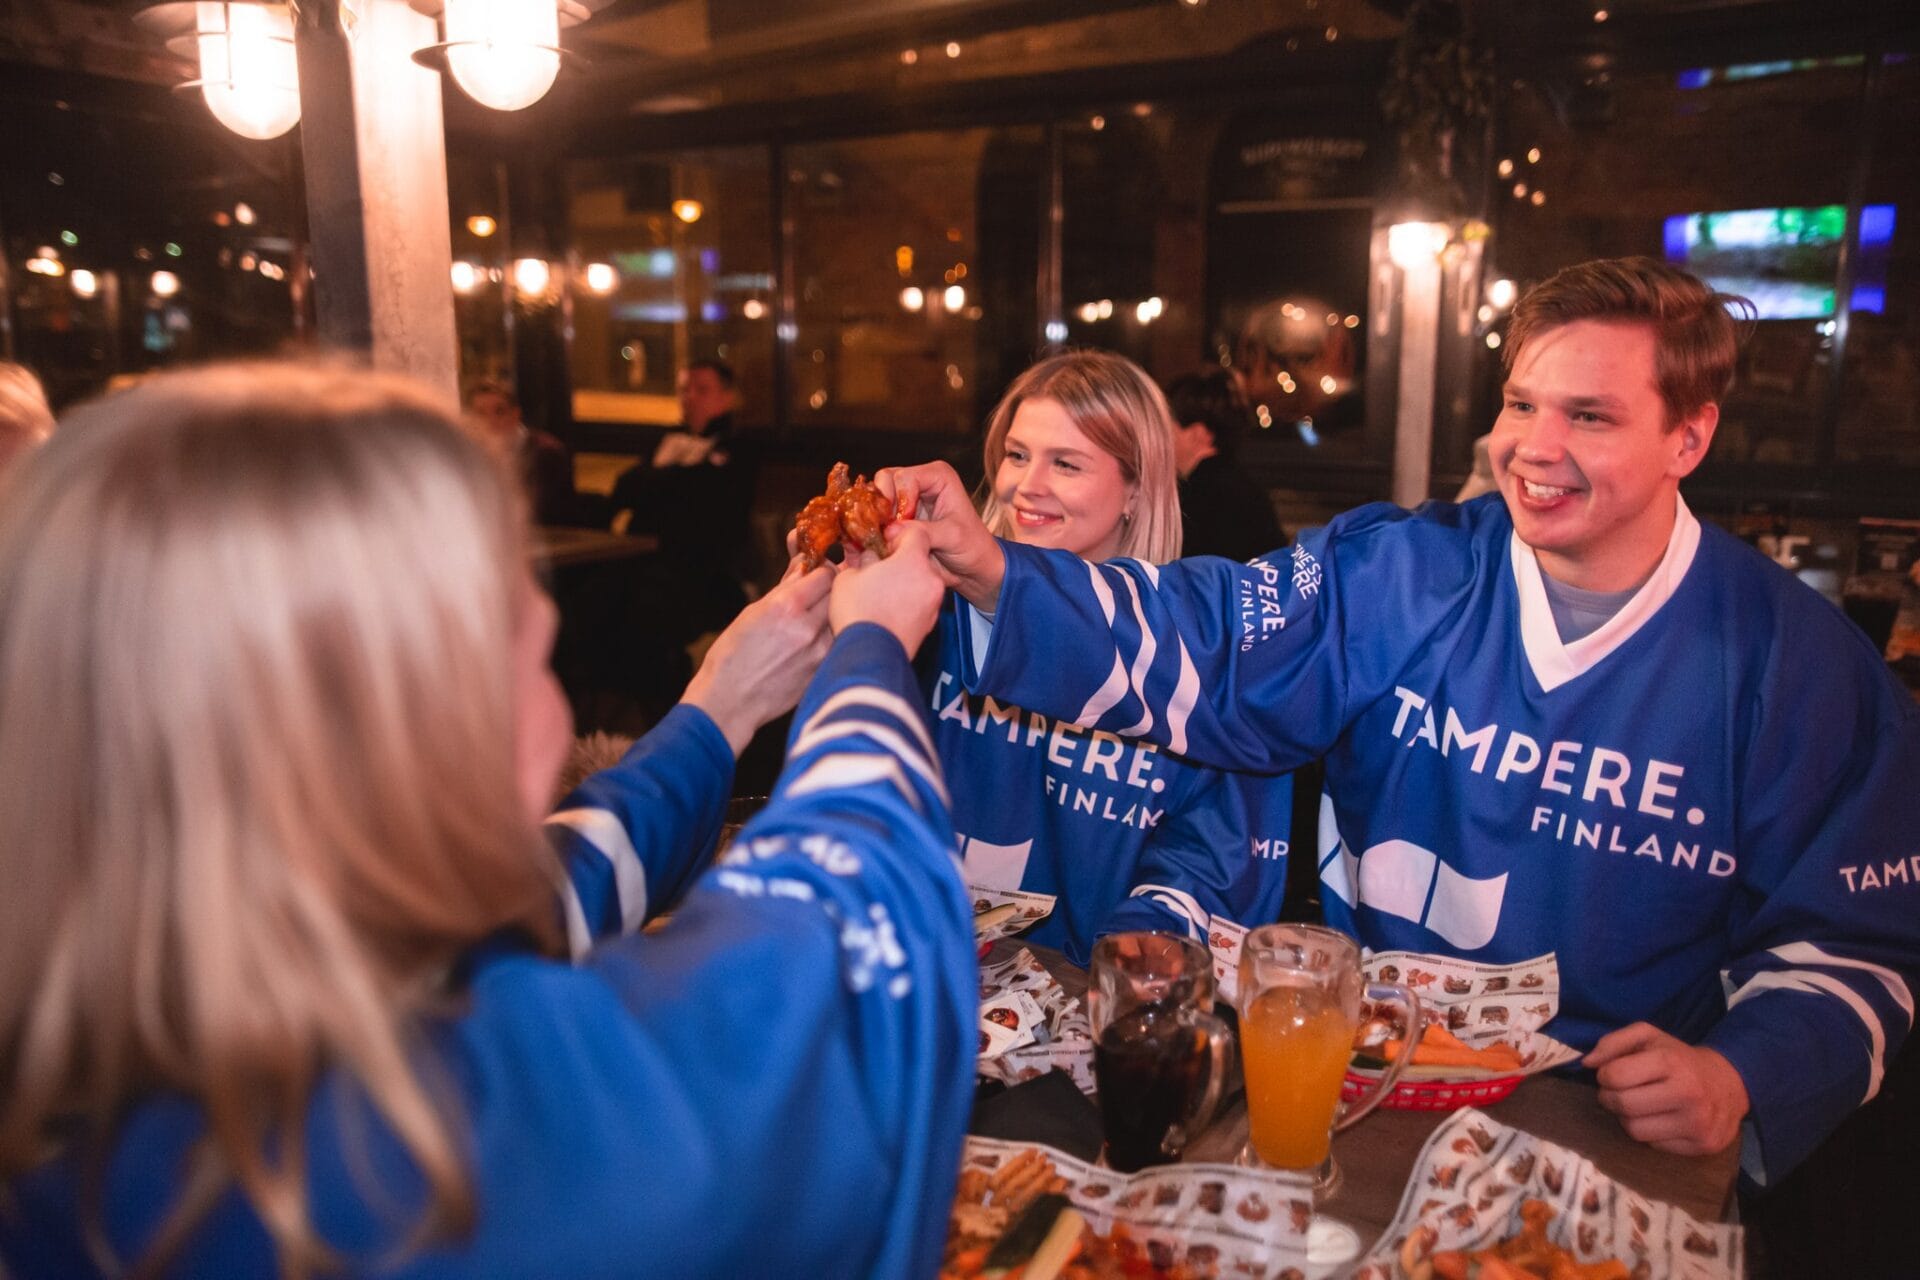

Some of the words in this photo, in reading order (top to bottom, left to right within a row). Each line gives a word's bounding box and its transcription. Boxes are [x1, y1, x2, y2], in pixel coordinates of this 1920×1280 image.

[1241, 579, 1256, 652] FINLAND
[1391, 685, 1705, 826] TAMPERE.
[1530, 806, 1737, 877] FINLAND
